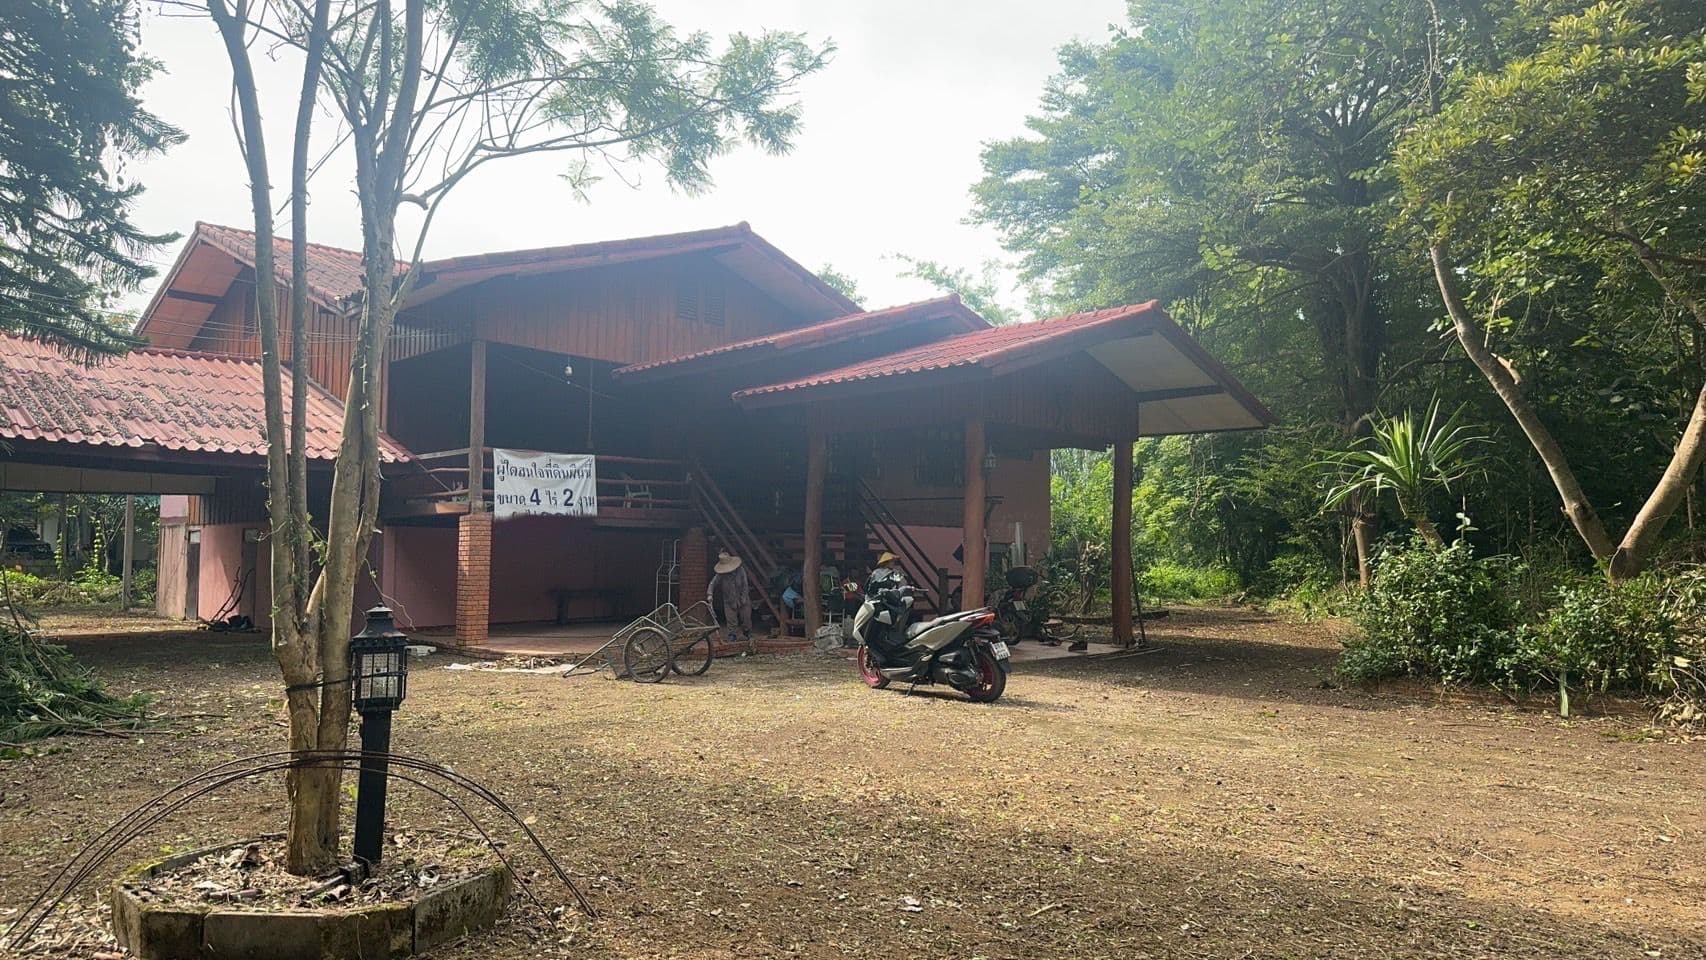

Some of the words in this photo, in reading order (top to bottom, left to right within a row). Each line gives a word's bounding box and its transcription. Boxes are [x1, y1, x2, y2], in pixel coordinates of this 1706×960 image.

[496, 493, 526, 506] ขนาด
[530, 488, 541, 506] 4
[545, 489, 558, 507] ไร่
[563, 488, 574, 506] 2
